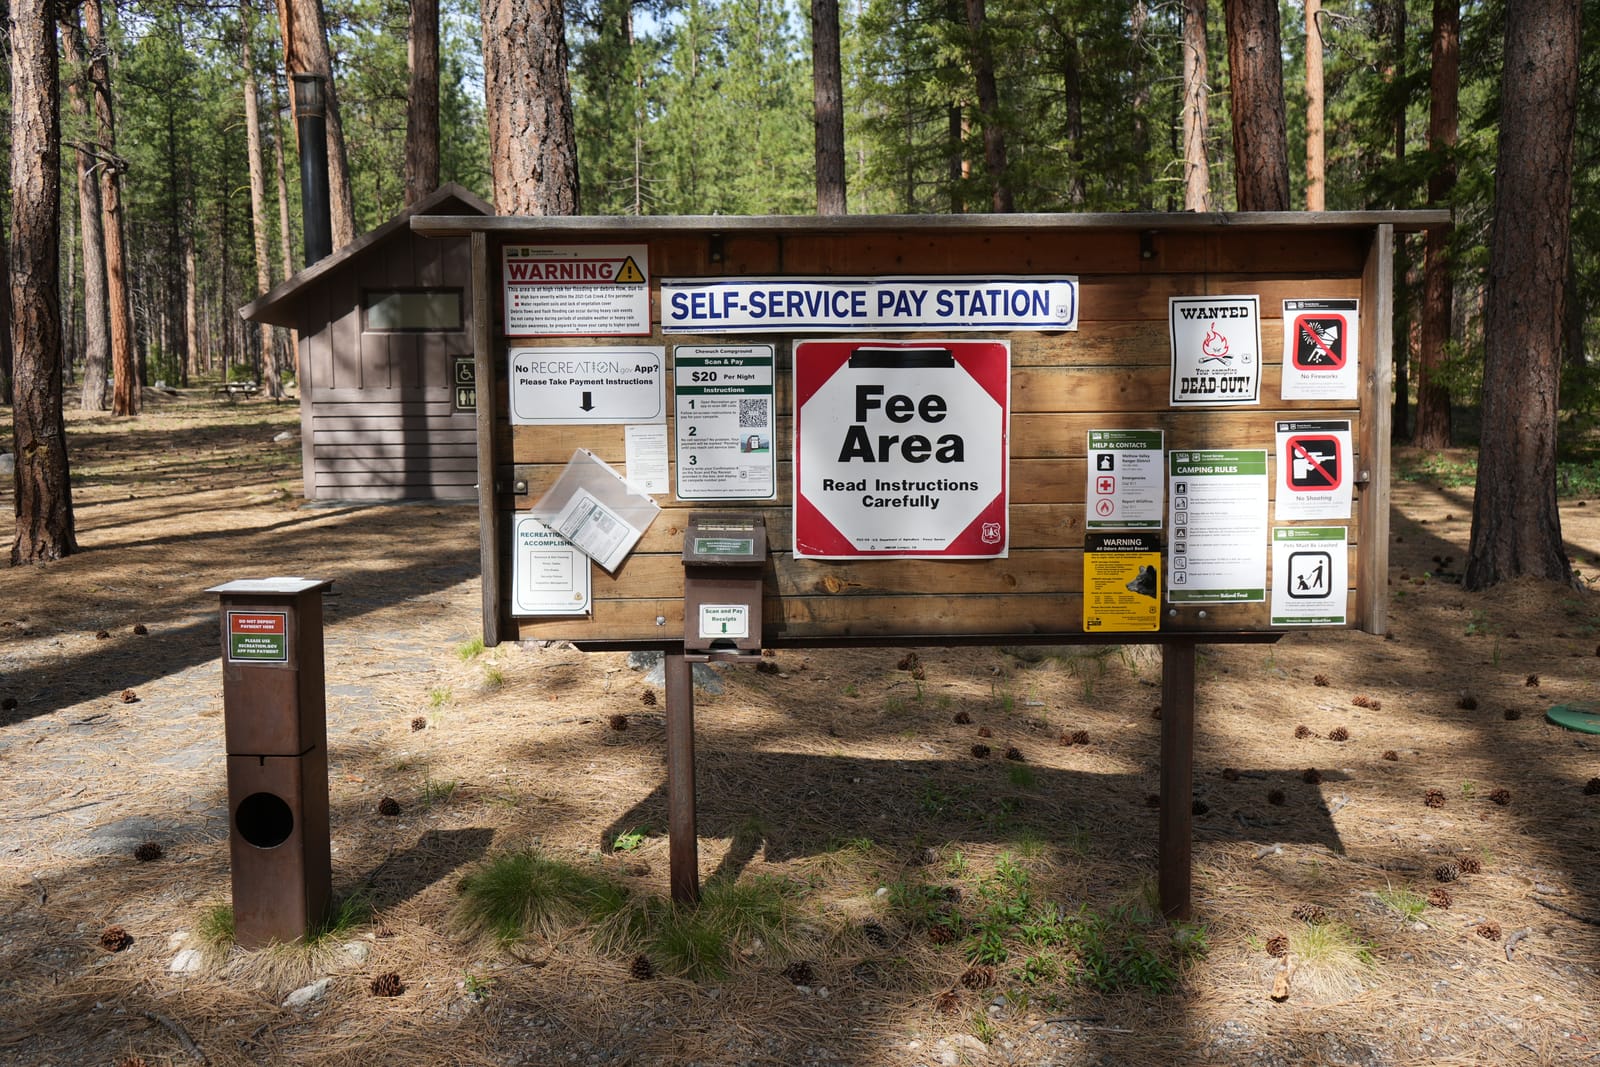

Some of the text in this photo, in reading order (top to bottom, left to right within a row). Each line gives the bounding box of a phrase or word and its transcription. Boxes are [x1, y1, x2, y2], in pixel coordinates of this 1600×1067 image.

[508, 264, 613, 280] WARNING
[671, 289, 1050, 320] SELF-SERVICE PAY STATION
[1180, 307, 1248, 320] WANTED
[515, 365, 528, 373] No
[634, 365, 659, 374] App?
[692, 371, 717, 382] $20
[688, 400, 695, 409] 1
[856, 385, 947, 423] Fee
[688, 426, 696, 436] 2
[838, 425, 965, 463] Area
[689, 455, 697, 465] 3
[823, 479, 978, 491] Read Instructions
[862, 495, 940, 510] Carefully
